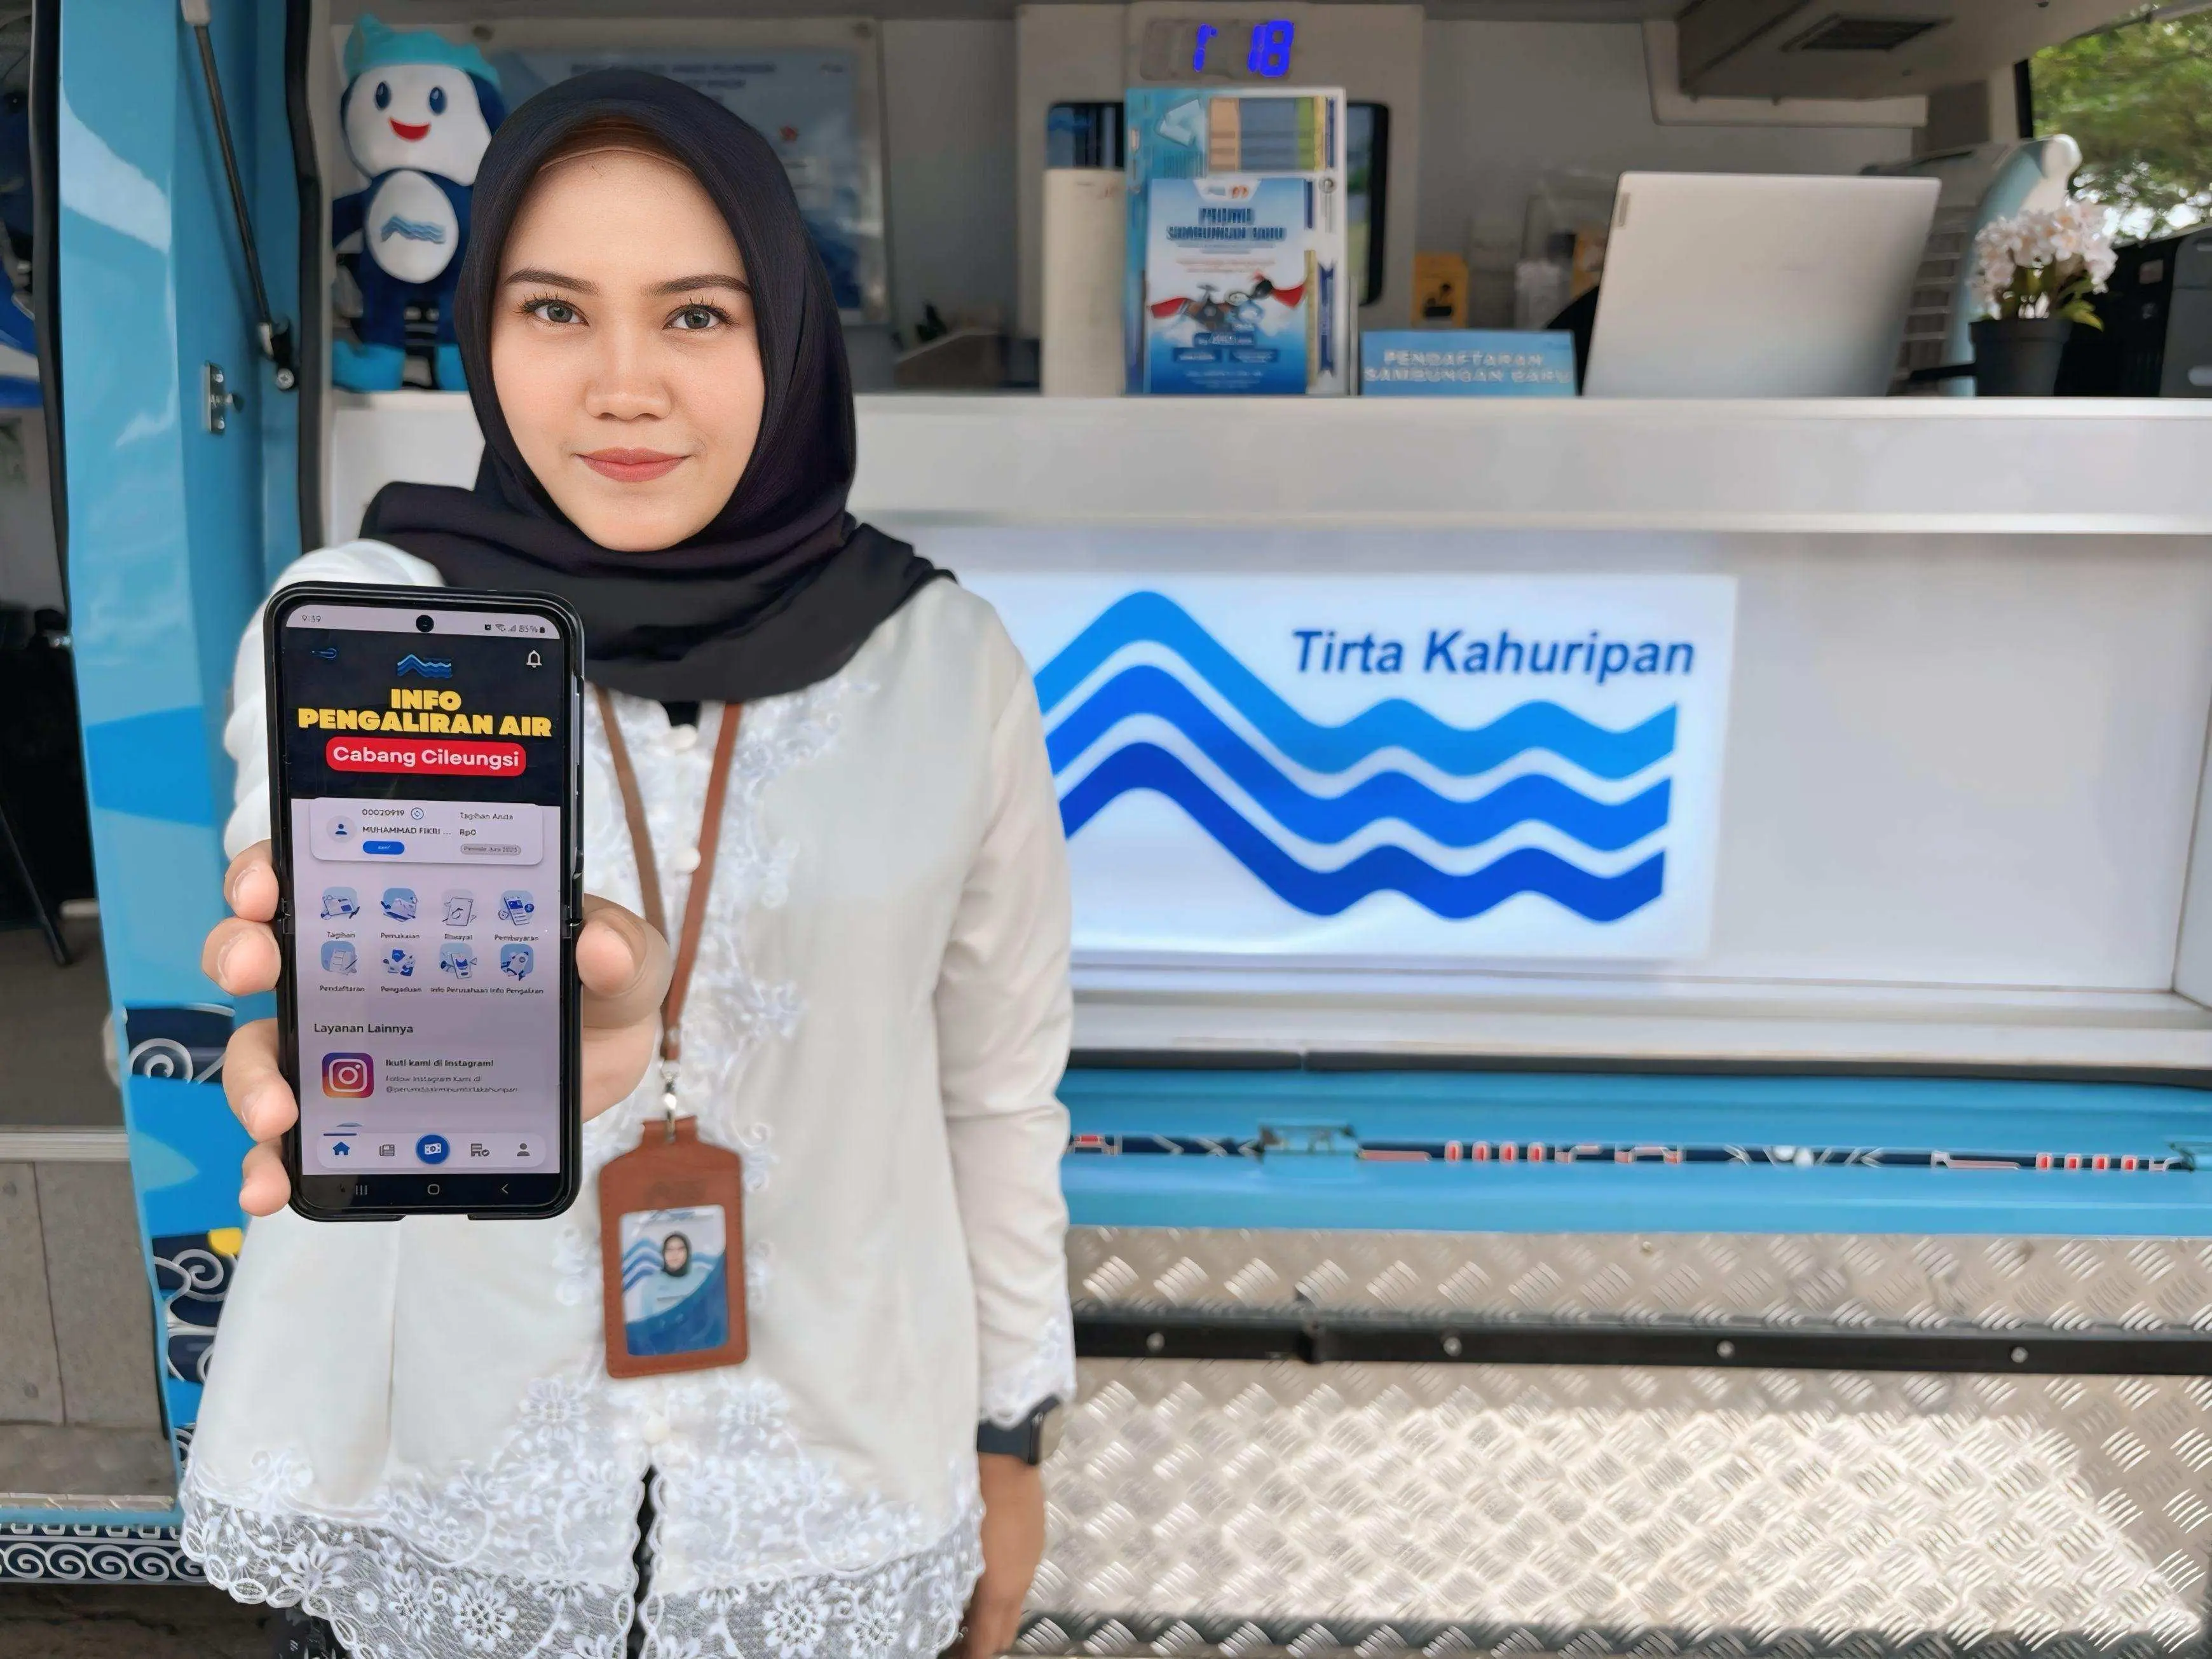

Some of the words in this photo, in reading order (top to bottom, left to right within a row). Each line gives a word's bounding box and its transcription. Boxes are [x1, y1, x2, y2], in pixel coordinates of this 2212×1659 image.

[1292, 629, 1405, 674] Tirta
[1422, 629, 1696, 685] Kahuripan
[390, 688, 462, 711] INFO
[297, 707, 493, 735] PENGALIRAN
[498, 716, 554, 737] AIR
[332, 746, 416, 768] Cabang
[421, 748, 519, 770] Cileungsi
[314, 1023, 364, 1035] Layanan
[367, 1024, 414, 1034] Lainnya
